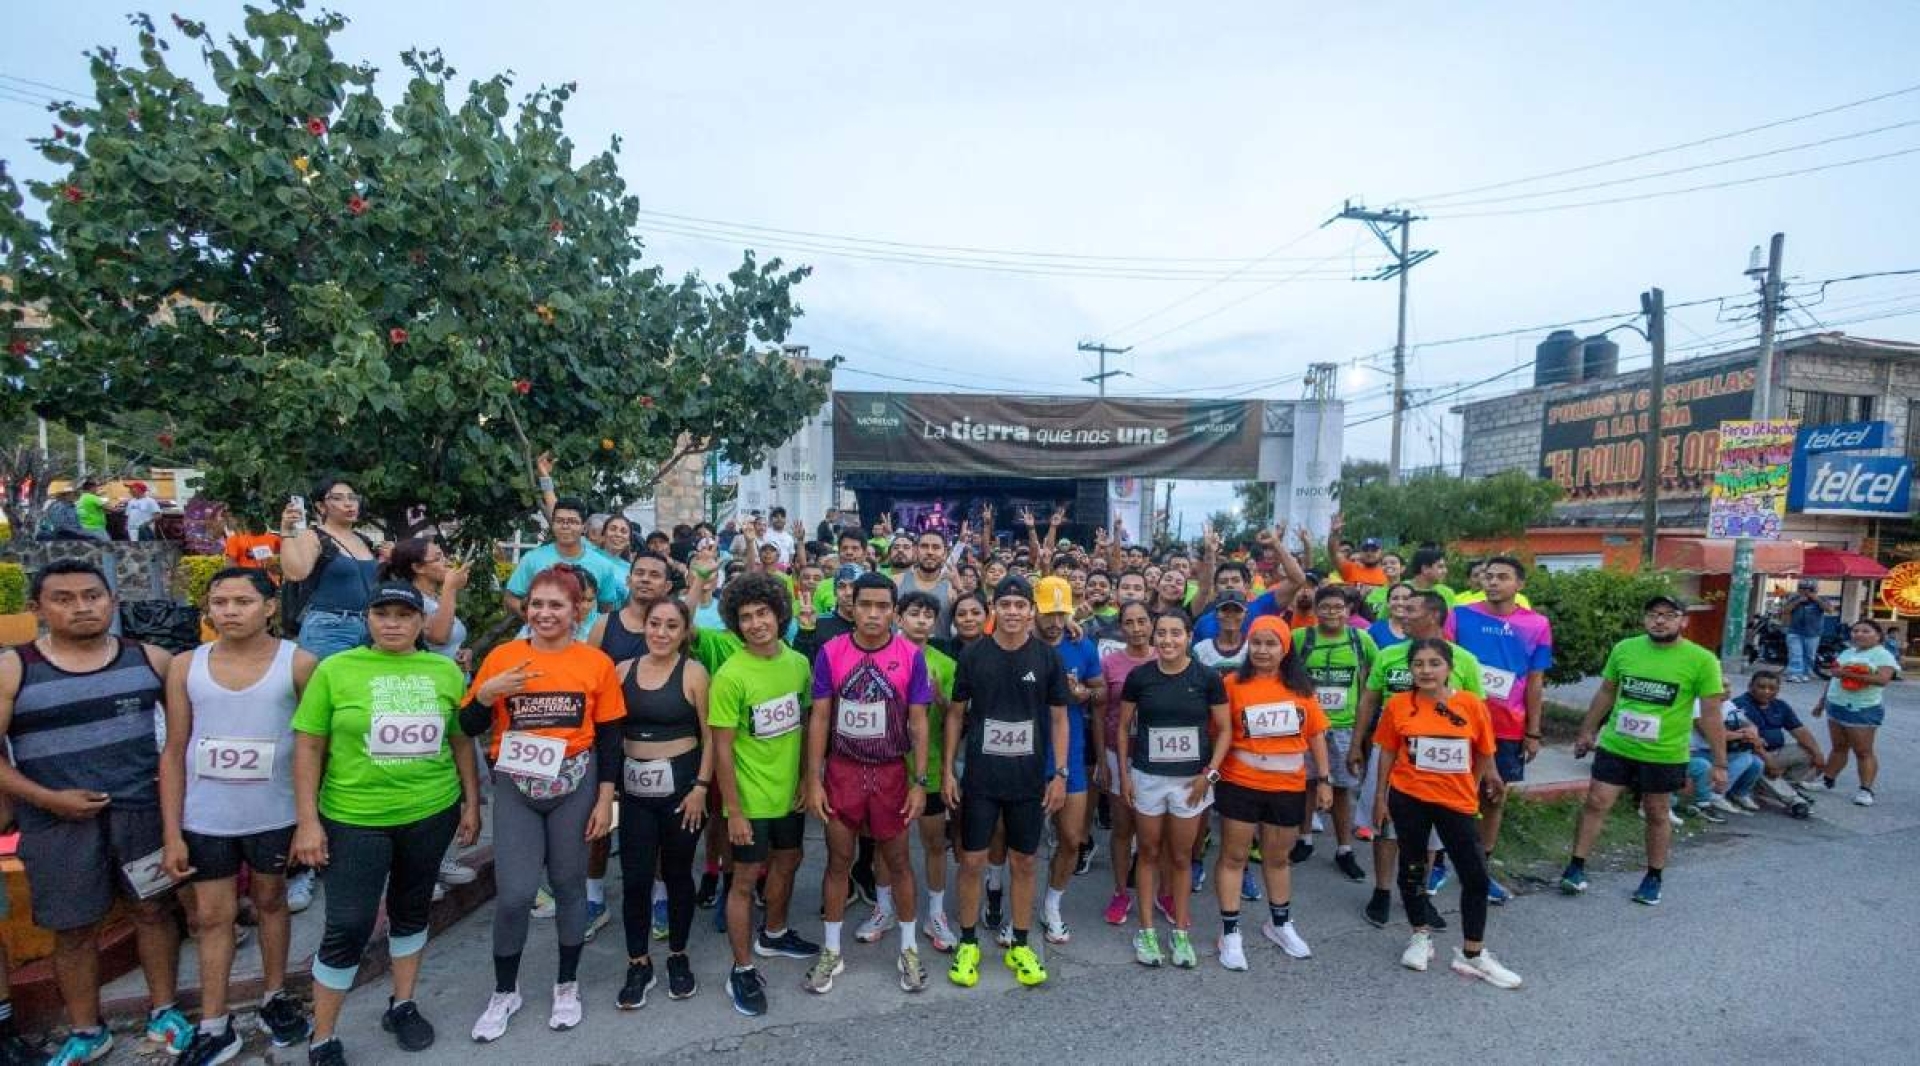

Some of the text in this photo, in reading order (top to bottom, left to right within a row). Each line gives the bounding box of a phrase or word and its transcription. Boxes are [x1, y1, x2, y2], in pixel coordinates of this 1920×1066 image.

[1635, 368, 1756, 411] CSTILLAS
[924, 416, 1168, 445] La tierra que nos une
[1805, 425, 1872, 449] telcel
[1576, 439, 1644, 488] POLLO
[1682, 429, 1721, 475] OR
[1808, 462, 1907, 504] telcel
[762, 700, 795, 726] 368
[844, 710, 877, 729] 051
[1255, 710, 1289, 728] 477
[379, 724, 438, 745] 060
[1623, 716, 1652, 732] 197
[989, 729, 1027, 747] 244
[1156, 735, 1191, 753] 148
[208, 748, 260, 770] 192
[507, 740, 556, 766] 390
[1423, 745, 1464, 764] 454
[628, 769, 665, 787] 467
